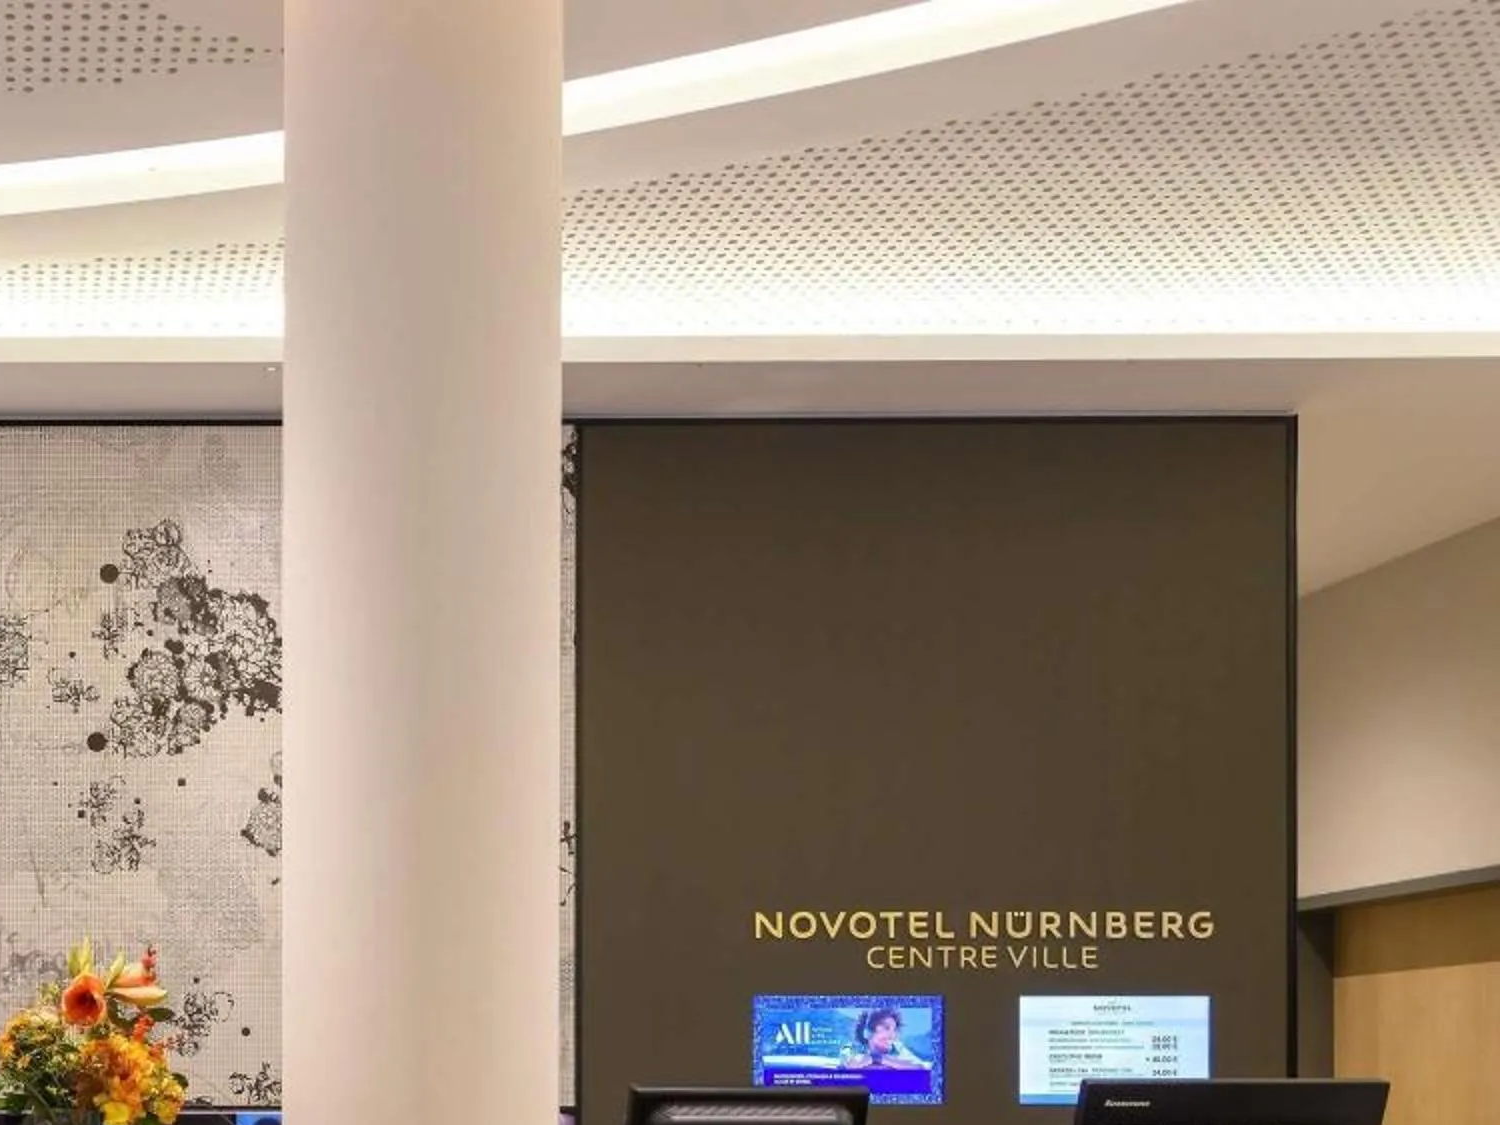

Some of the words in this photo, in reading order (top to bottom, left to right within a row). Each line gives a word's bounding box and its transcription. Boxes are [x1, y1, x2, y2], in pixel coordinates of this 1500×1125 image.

[755, 911, 954, 939] NOVOTEL
[969, 910, 1215, 939] NÜRNBERG
[867, 945, 997, 969] CENTRE
[1006, 945, 1099, 969] VILLE
